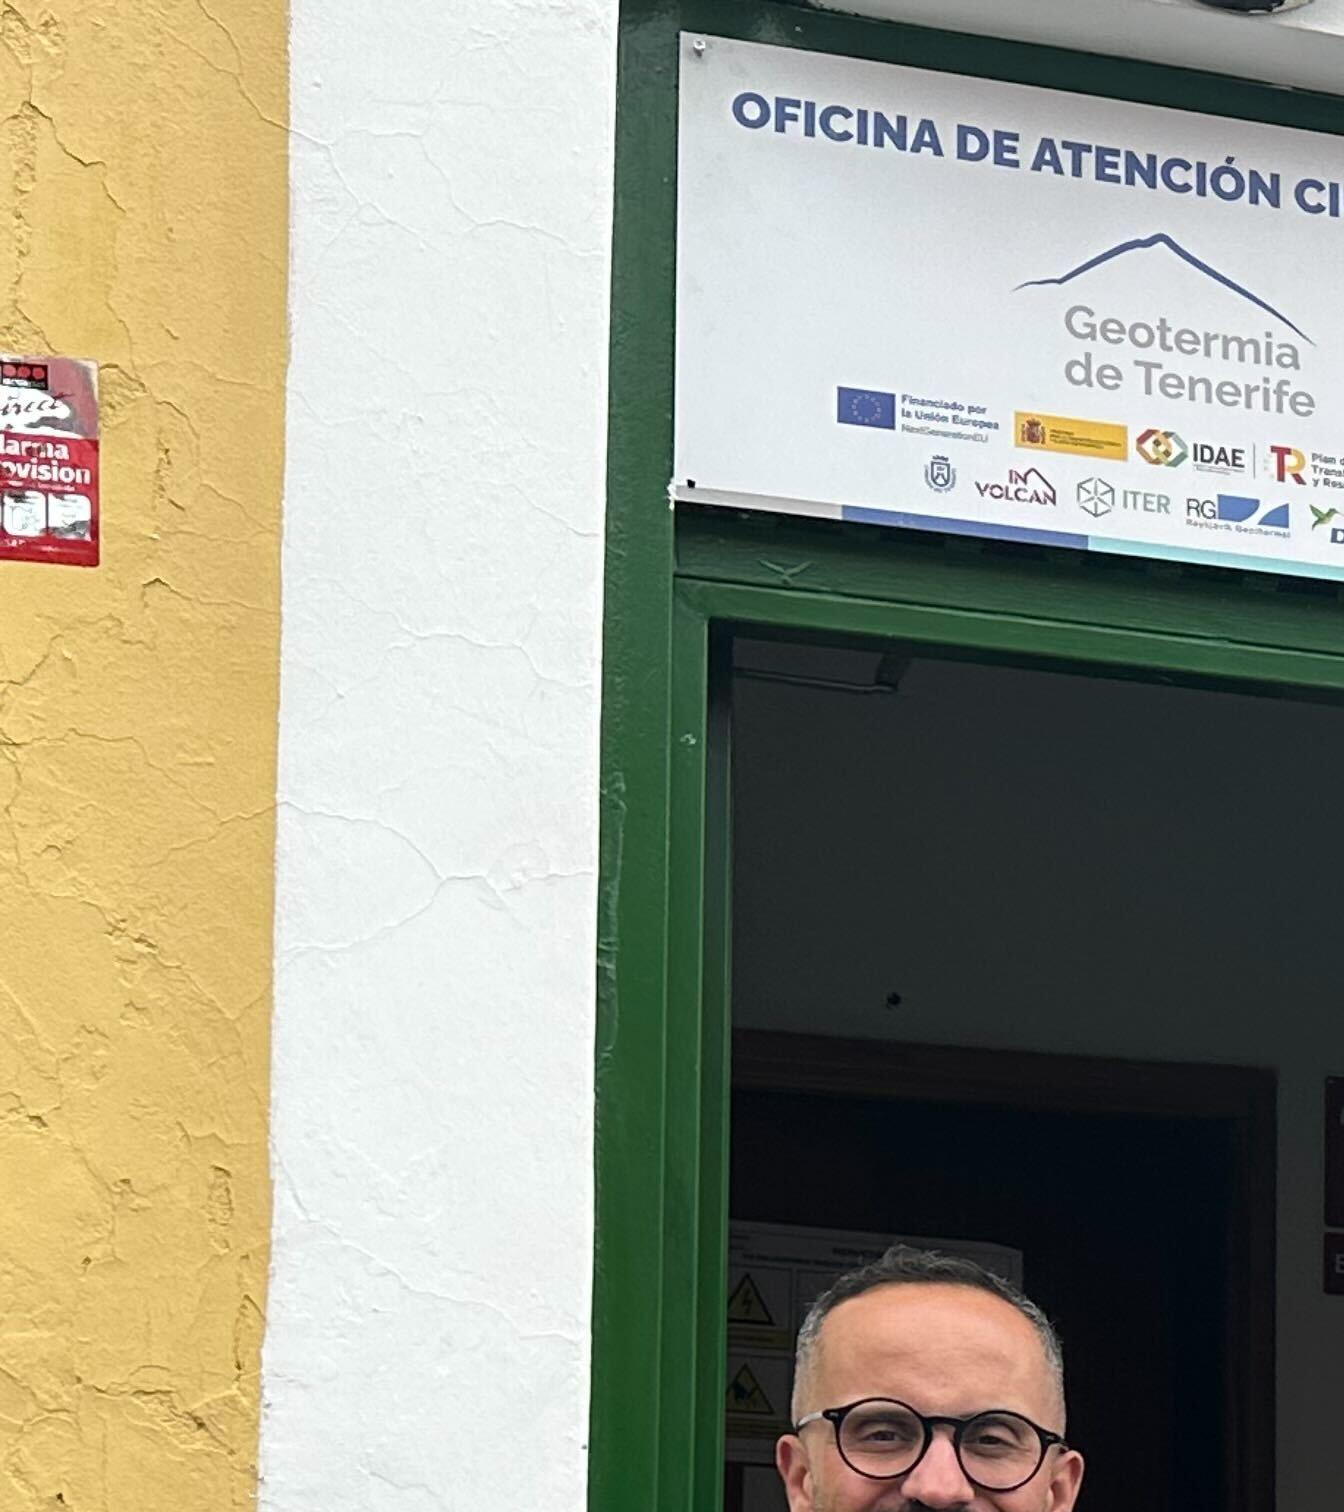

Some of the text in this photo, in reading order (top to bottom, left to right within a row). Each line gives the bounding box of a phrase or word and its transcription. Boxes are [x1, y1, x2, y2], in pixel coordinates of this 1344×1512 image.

[733, 91, 944, 158] OFICINA
[956, 124, 1020, 169] DE
[1031, 136, 1280, 209] ATENCIÓN
[1063, 304, 1301, 371] Geotermia
[1064, 351, 1316, 418] de Tenerife
[901, 394, 988, 416] Financiado por
[901, 407, 1000, 431] la Unión Europea
[1192, 442, 1246, 469] IDAE
[1311, 452, 1337, 465] Plan
[1008, 468, 1028, 486] IN
[1311, 477, 1320, 488] y
[974, 480, 1057, 507] VOLCAN
[1122, 489, 1172, 515] ITER
[1185, 497, 1217, 520] RG
